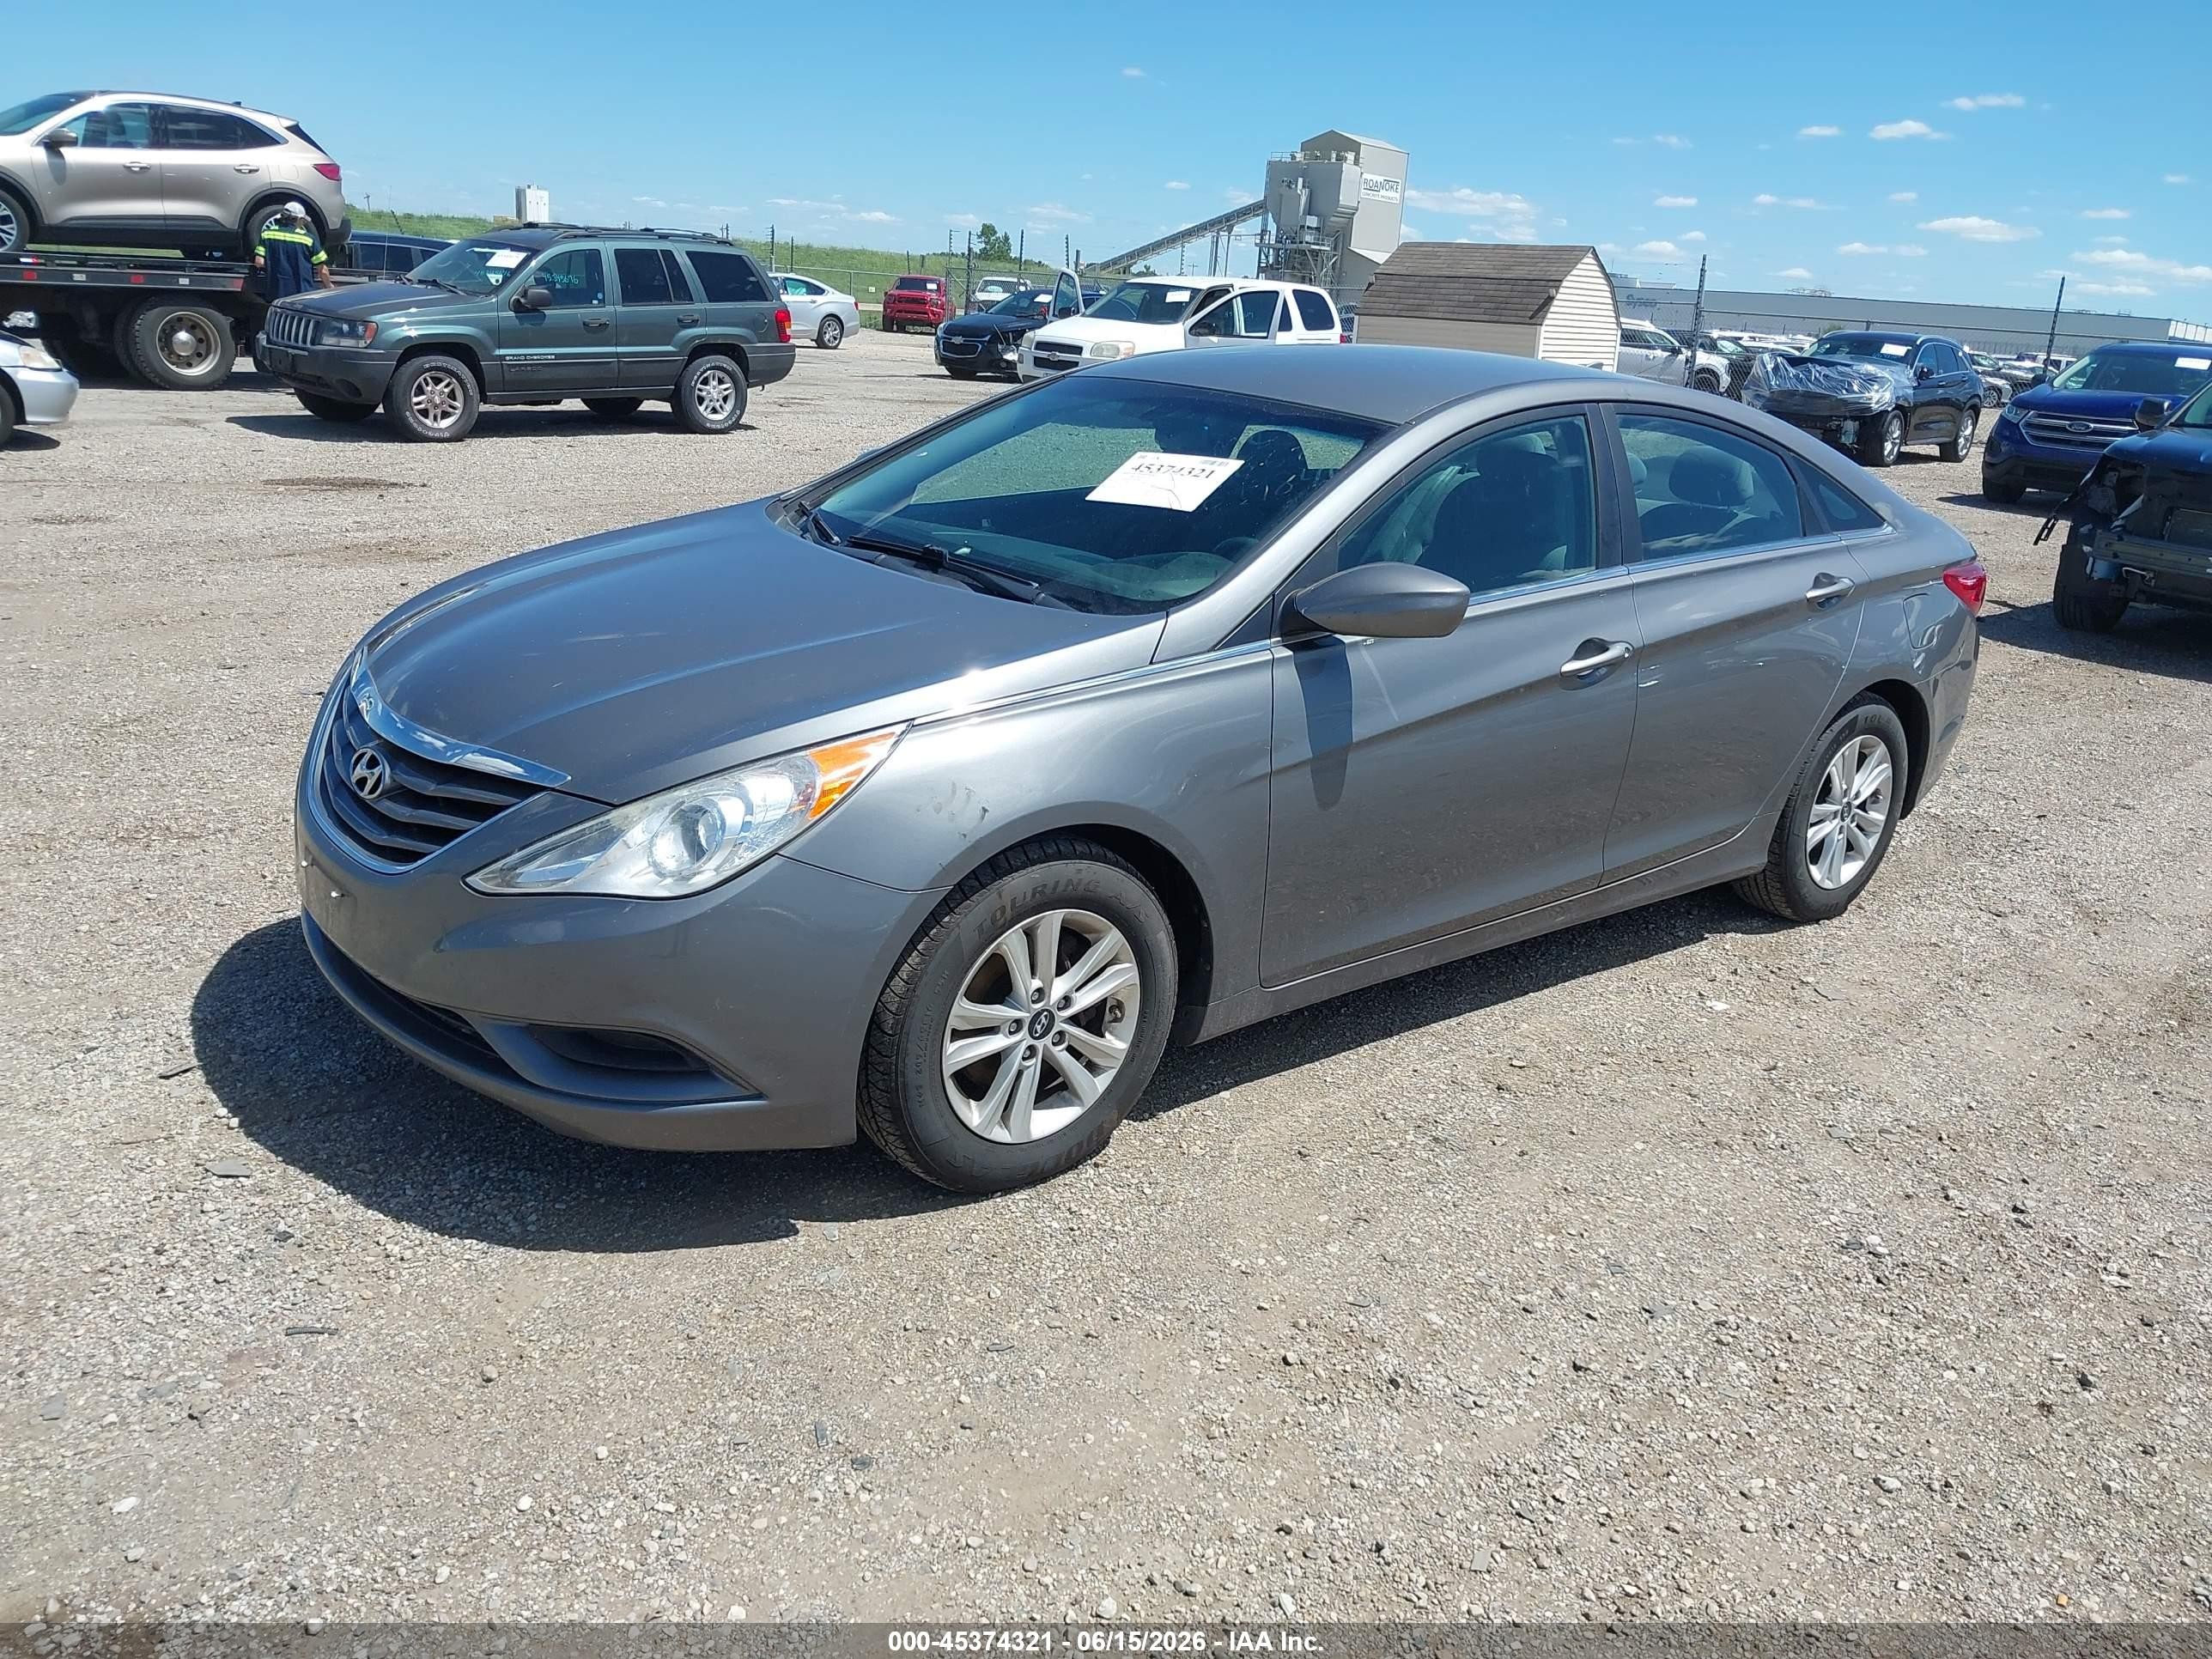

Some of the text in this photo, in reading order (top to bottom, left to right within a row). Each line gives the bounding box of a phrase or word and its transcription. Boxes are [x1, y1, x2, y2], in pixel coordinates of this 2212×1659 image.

[1363, 178, 1400, 193] ROANOKE
[1132, 463, 1216, 478] 45374321
[971, 877, 1101, 939] TOURING
